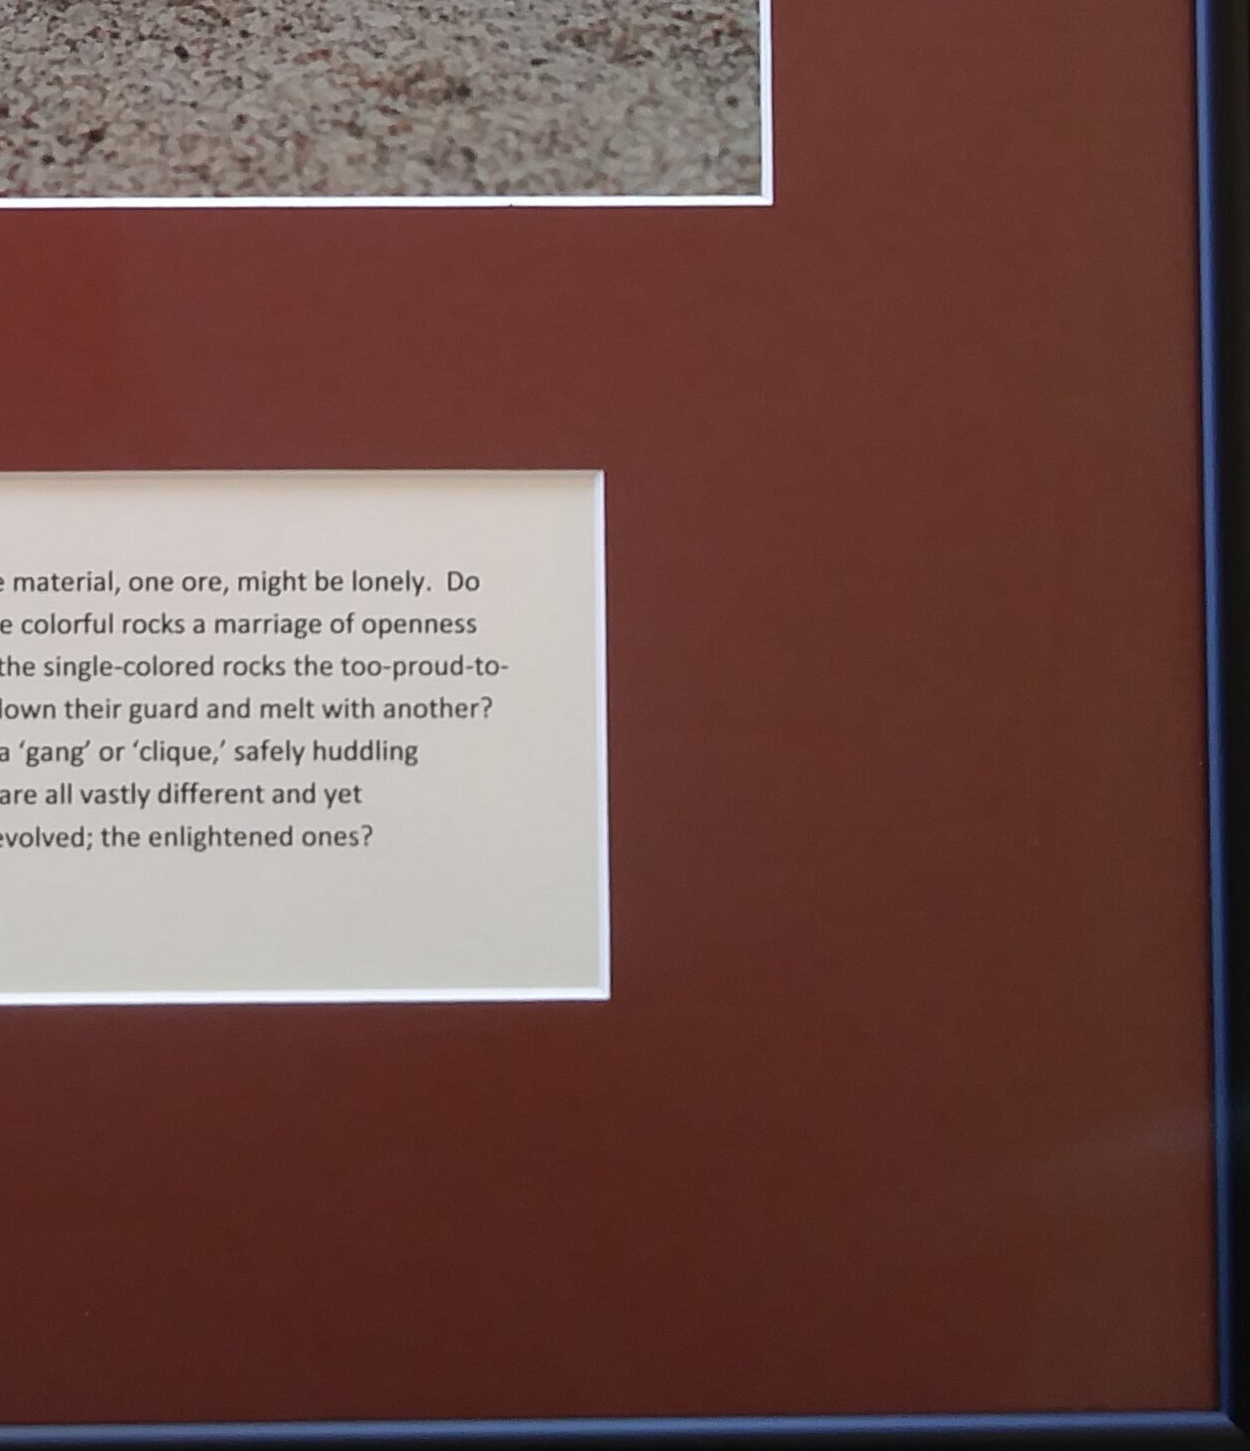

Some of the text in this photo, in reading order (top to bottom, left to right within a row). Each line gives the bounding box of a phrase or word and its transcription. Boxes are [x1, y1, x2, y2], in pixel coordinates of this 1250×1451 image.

[12, 569, 121, 597] material,
[128, 575, 175, 593] one
[181, 575, 230, 597] ore,
[237, 569, 308, 597] might
[314, 569, 345, 592] be
[351, 569, 432, 598] lonely.
[447, 570, 481, 593] Do
[20, 611, 114, 635] colorful
[121, 611, 186, 635] rocks
[192, 617, 206, 635] a
[214, 612, 323, 640] marriage
[329, 611, 356, 635] of
[361, 617, 478, 640] openness
[43, 654, 215, 683] single-colored
[222, 653, 287, 677] rocks
[293, 653, 334, 678] the
[340, 653, 509, 682] too-proud-to-
[63, 697, 123, 720] their
[128, 696, 199, 725] guard
[206, 696, 251, 720] and
[259, 696, 315, 720] melt
[321, 696, 376, 720] with
[382, 695, 493, 720] another?
[18, 739, 91, 768] ‘gang’
[98, 745, 126, 763] or
[132, 738, 226, 768] ‘clique,’
[233, 738, 306, 767] safely
[312, 738, 419, 767] huddling
[44, 782, 73, 805] all
[79, 781, 151, 810] vastly
[157, 781, 265, 805] different
[271, 781, 316, 805] and
[323, 784, 363, 810] yet
[100, 824, 141, 848] the
[148, 824, 294, 853] enlightened
[301, 824, 374, 848] ones?
